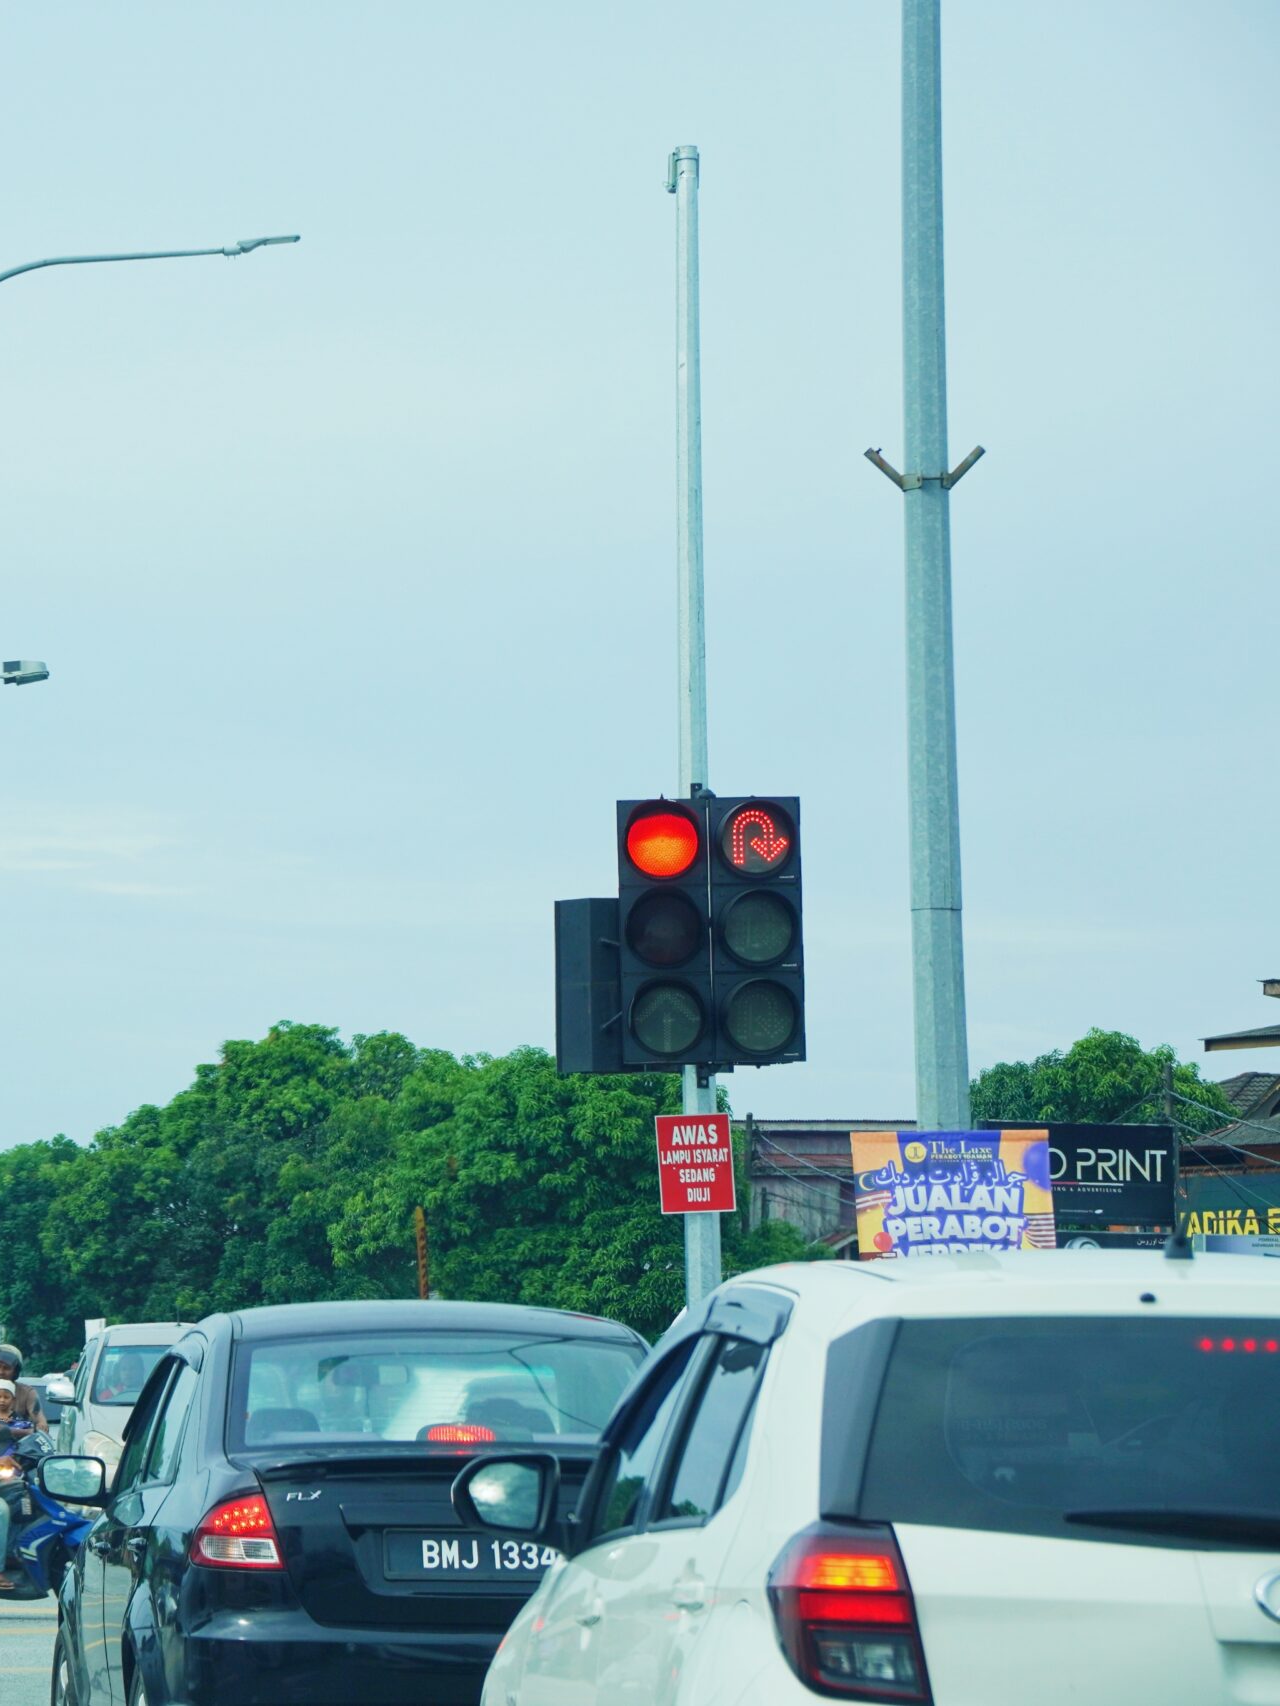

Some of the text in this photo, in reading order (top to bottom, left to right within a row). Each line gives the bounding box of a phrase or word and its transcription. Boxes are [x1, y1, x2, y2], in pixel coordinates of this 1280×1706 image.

[671, 1123, 718, 1146] AWAS
[660, 1147, 728, 1165] LAMPU ISYARAT
[928, 1140, 993, 1154] The Luxe
[1076, 1148, 1167, 1182] PRINT
[679, 1168, 716, 1183] SEDANG
[687, 1187, 710, 1202] DIUJI
[1077, 1186, 1123, 1194] ADVERTISING
[887, 1184, 1020, 1215] JUALAN
[886, 1214, 1024, 1243] PERABOT
[286, 1490, 321, 1502] FLX
[422, 1540, 556, 1569] BMJ 1334
